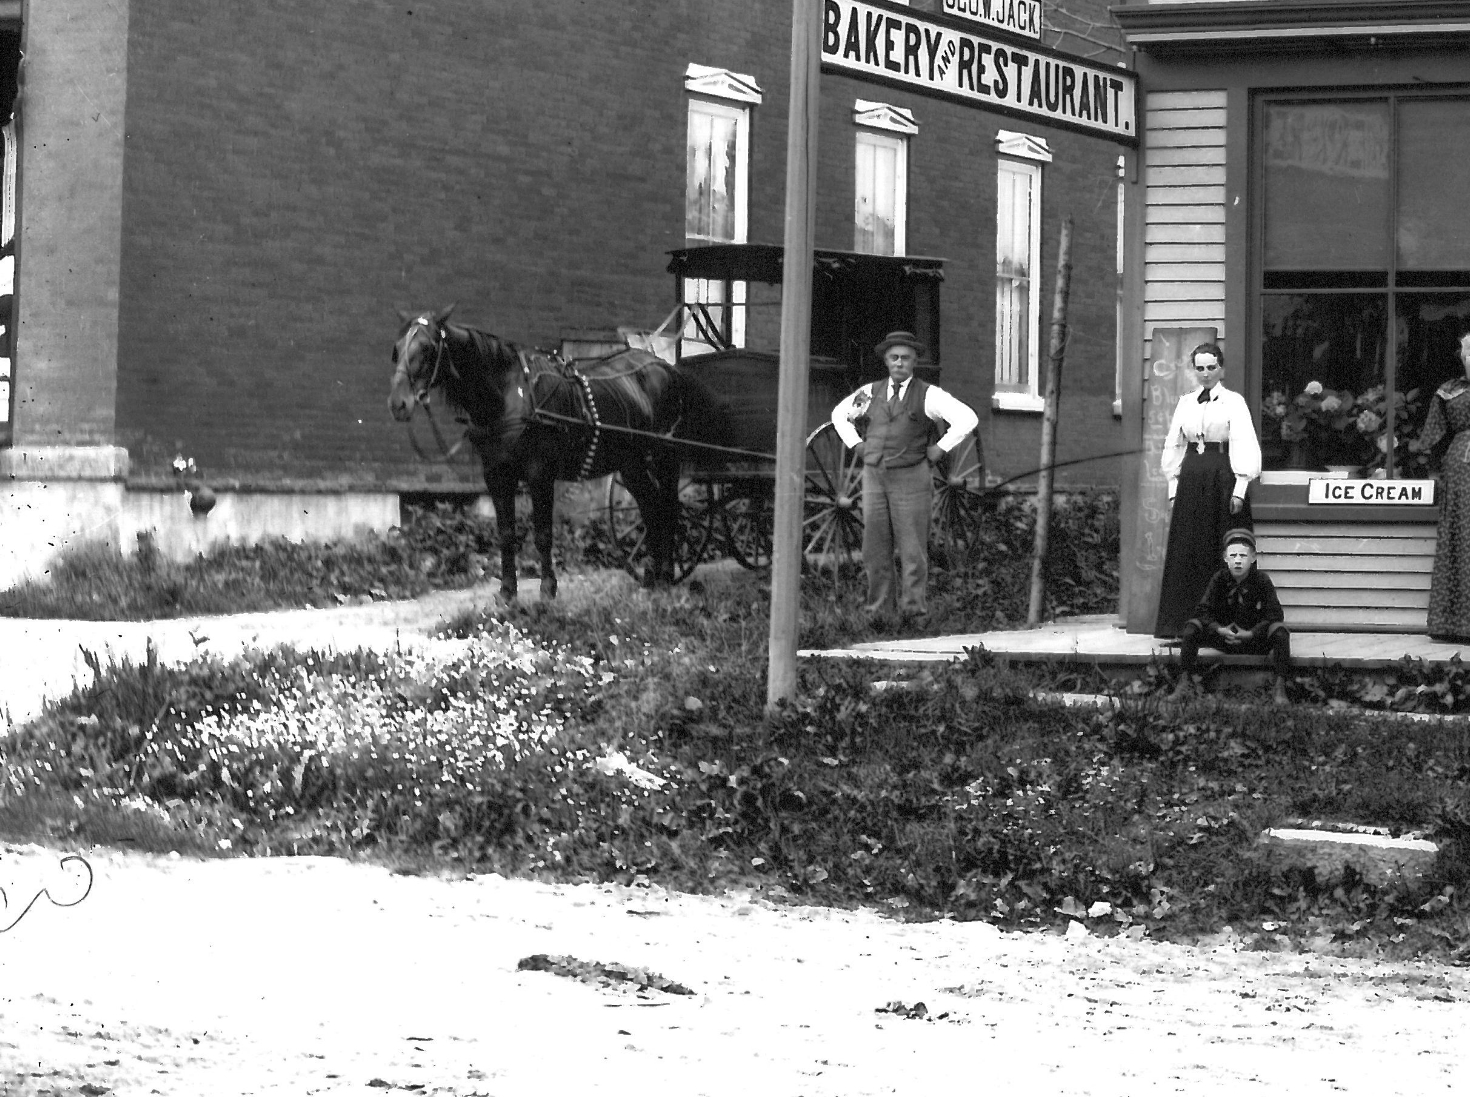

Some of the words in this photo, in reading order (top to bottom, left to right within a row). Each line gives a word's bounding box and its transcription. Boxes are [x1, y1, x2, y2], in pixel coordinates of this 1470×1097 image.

[823, 0, 942, 81] BAKERY
[937, 40, 956, 81] AND
[958, 36, 1130, 130] RESTAURANT.
[1324, 482, 1355, 500] ICE
[1361, 482, 1422, 500] CREAM
